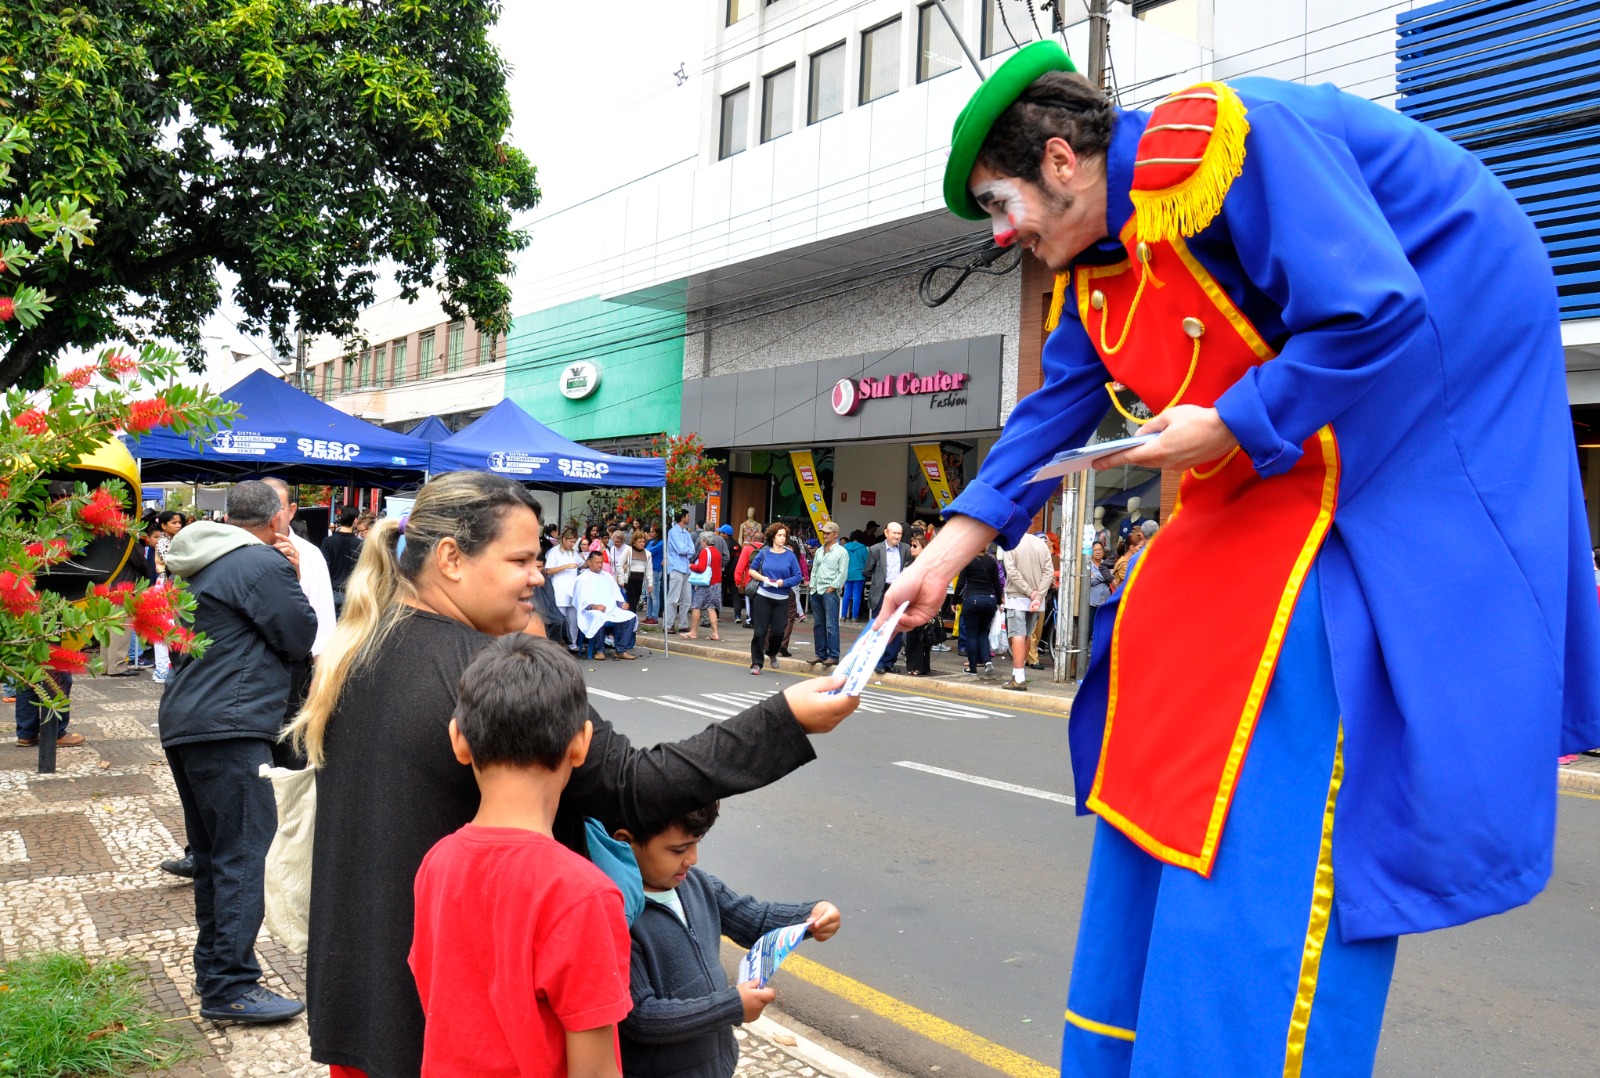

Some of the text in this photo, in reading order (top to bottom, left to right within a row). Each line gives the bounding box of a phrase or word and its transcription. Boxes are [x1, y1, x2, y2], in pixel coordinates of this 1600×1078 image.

[859, 370, 967, 400] Sul Center
[930, 394, 967, 409] Fashion
[297, 438, 360, 457] SESC
[557, 458, 610, 475] SESC
